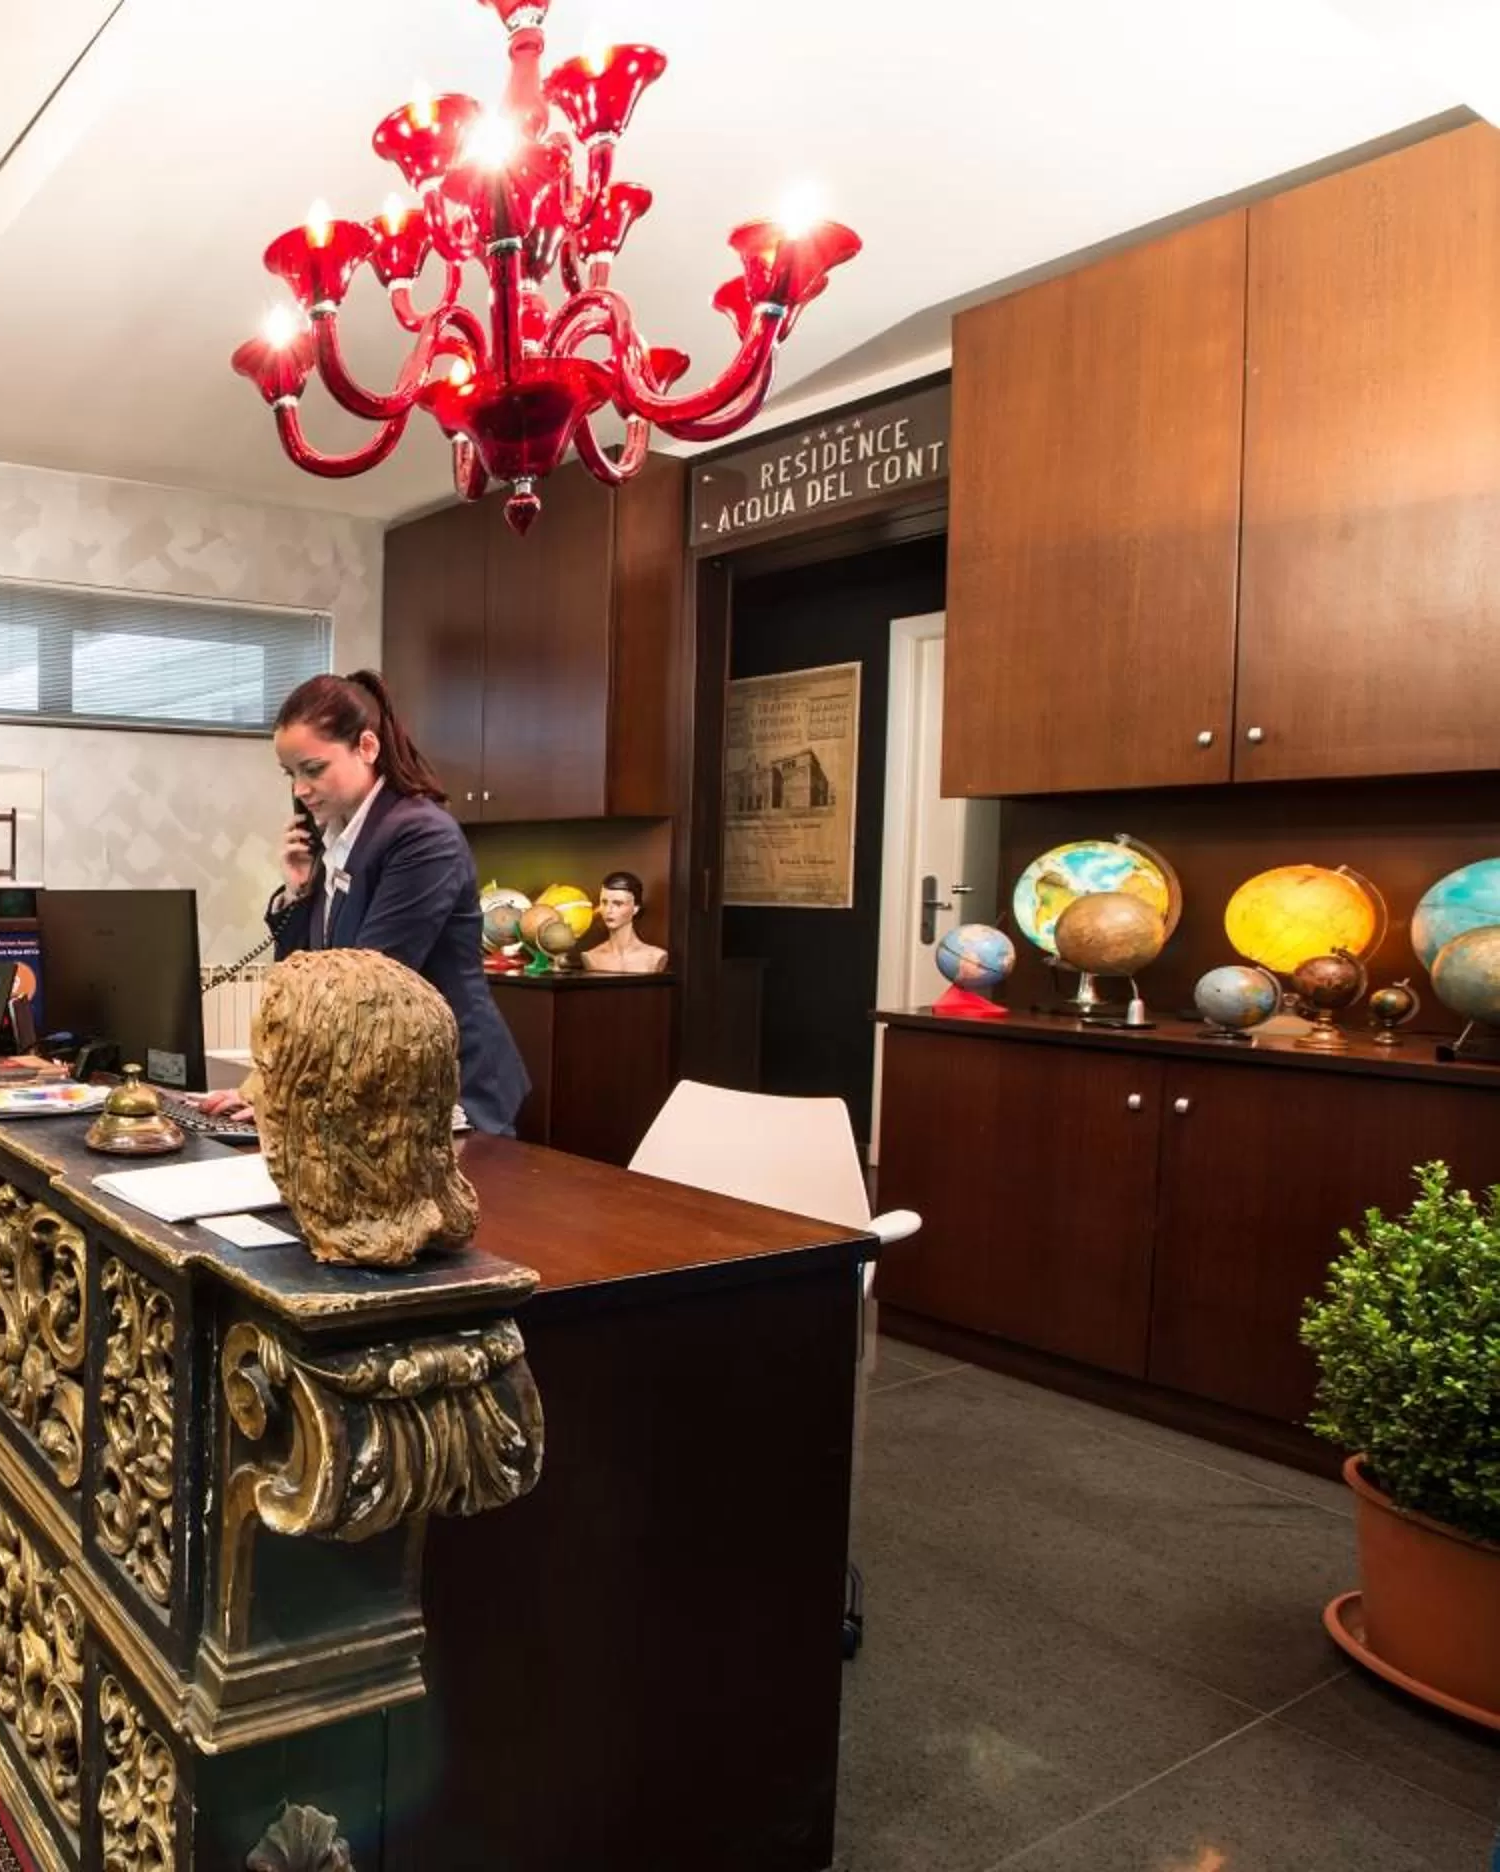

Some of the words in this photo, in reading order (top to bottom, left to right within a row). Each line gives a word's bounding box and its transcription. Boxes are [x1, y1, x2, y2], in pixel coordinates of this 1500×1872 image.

[716, 487, 796, 533] ACQUA
[806, 472, 853, 508] DEL
[866, 441, 948, 490] CONT
[760, 418, 910, 490] RESIDENCE
